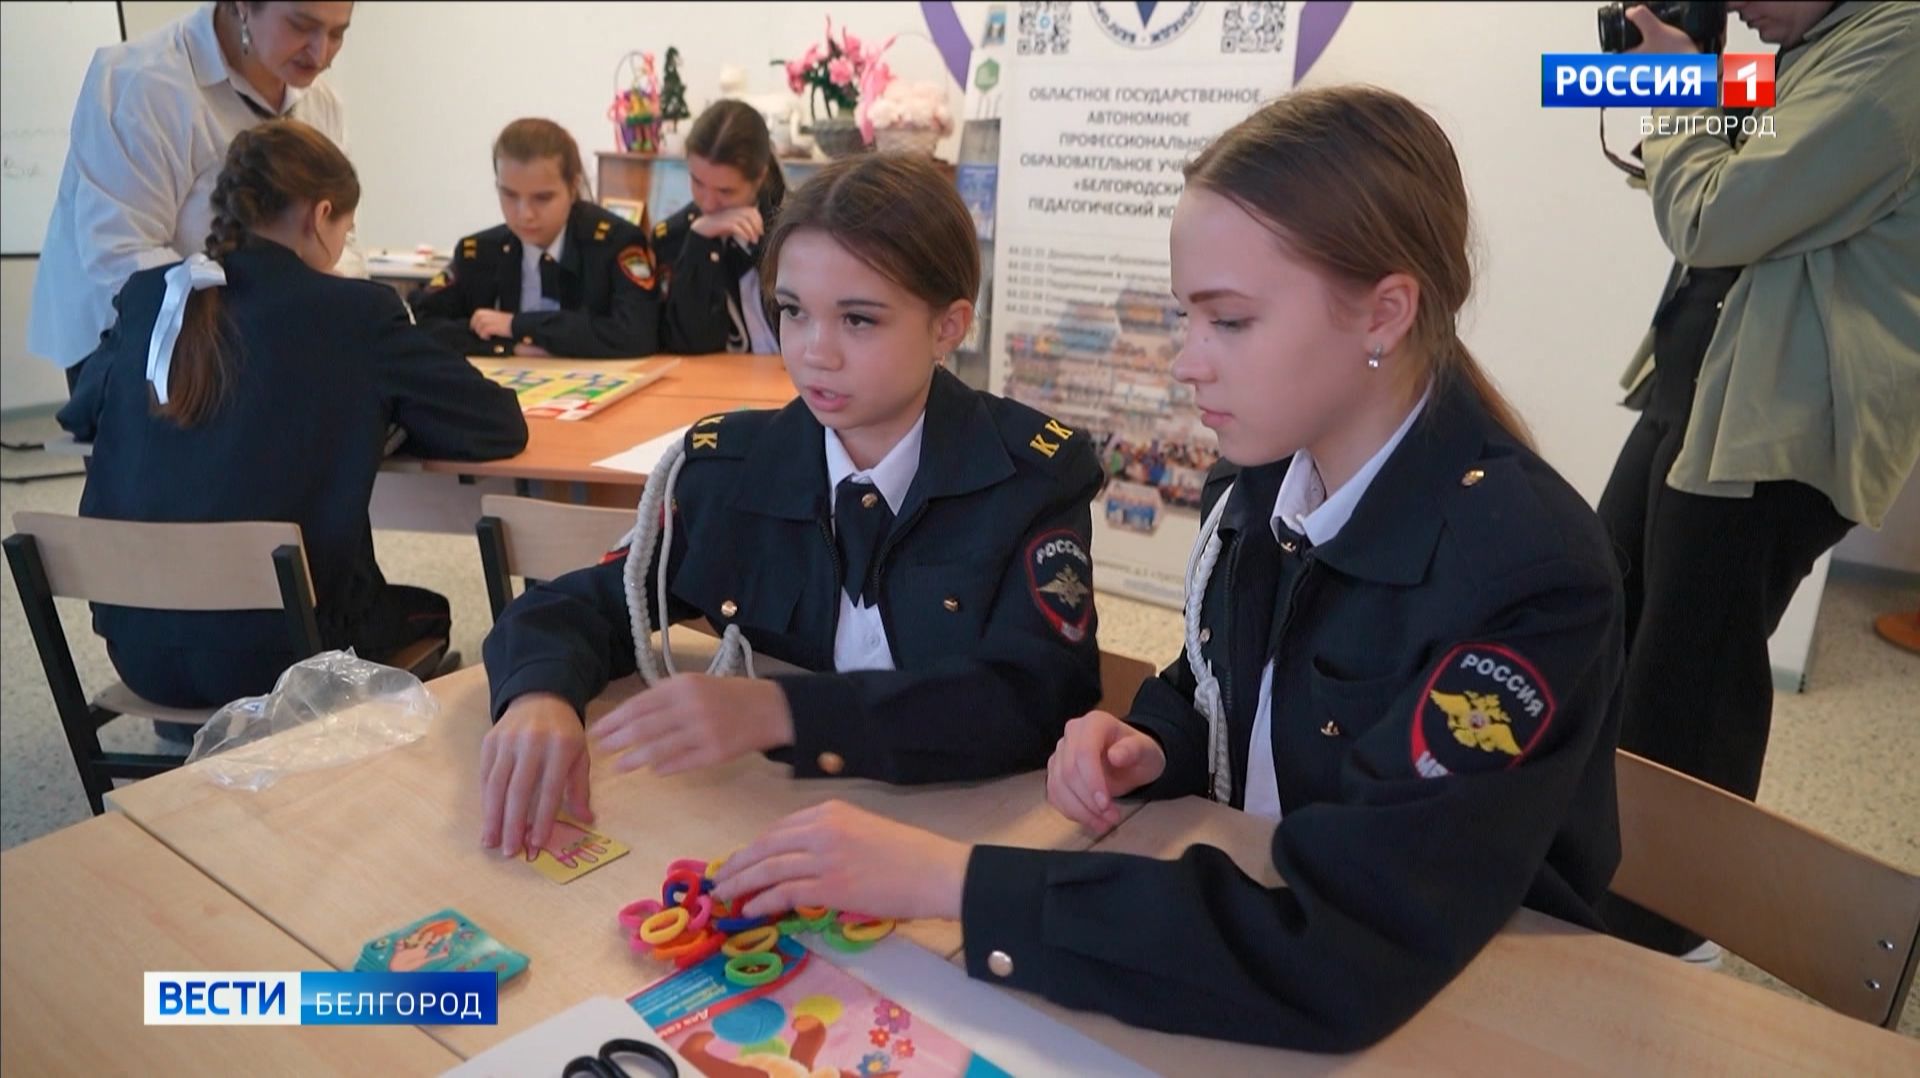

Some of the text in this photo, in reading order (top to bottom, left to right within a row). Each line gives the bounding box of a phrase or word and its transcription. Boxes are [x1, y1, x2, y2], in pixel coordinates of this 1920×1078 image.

[1029, 87, 1259, 103] ОБЛАСТНОЕ ГОСУДАРСТВЕННОЕ
[1087, 111, 1190, 127] АВТОНОМНОЕ
[1020, 153, 1152, 172] ОБРАЗОВАТЕЛЬНОЕ
[1028, 197, 1153, 216] ПЕДАГОГИЧЕСКИЙ
[1036, 539, 1089, 566] РОССИЯ
[1460, 653, 1545, 718] РОССИЯ
